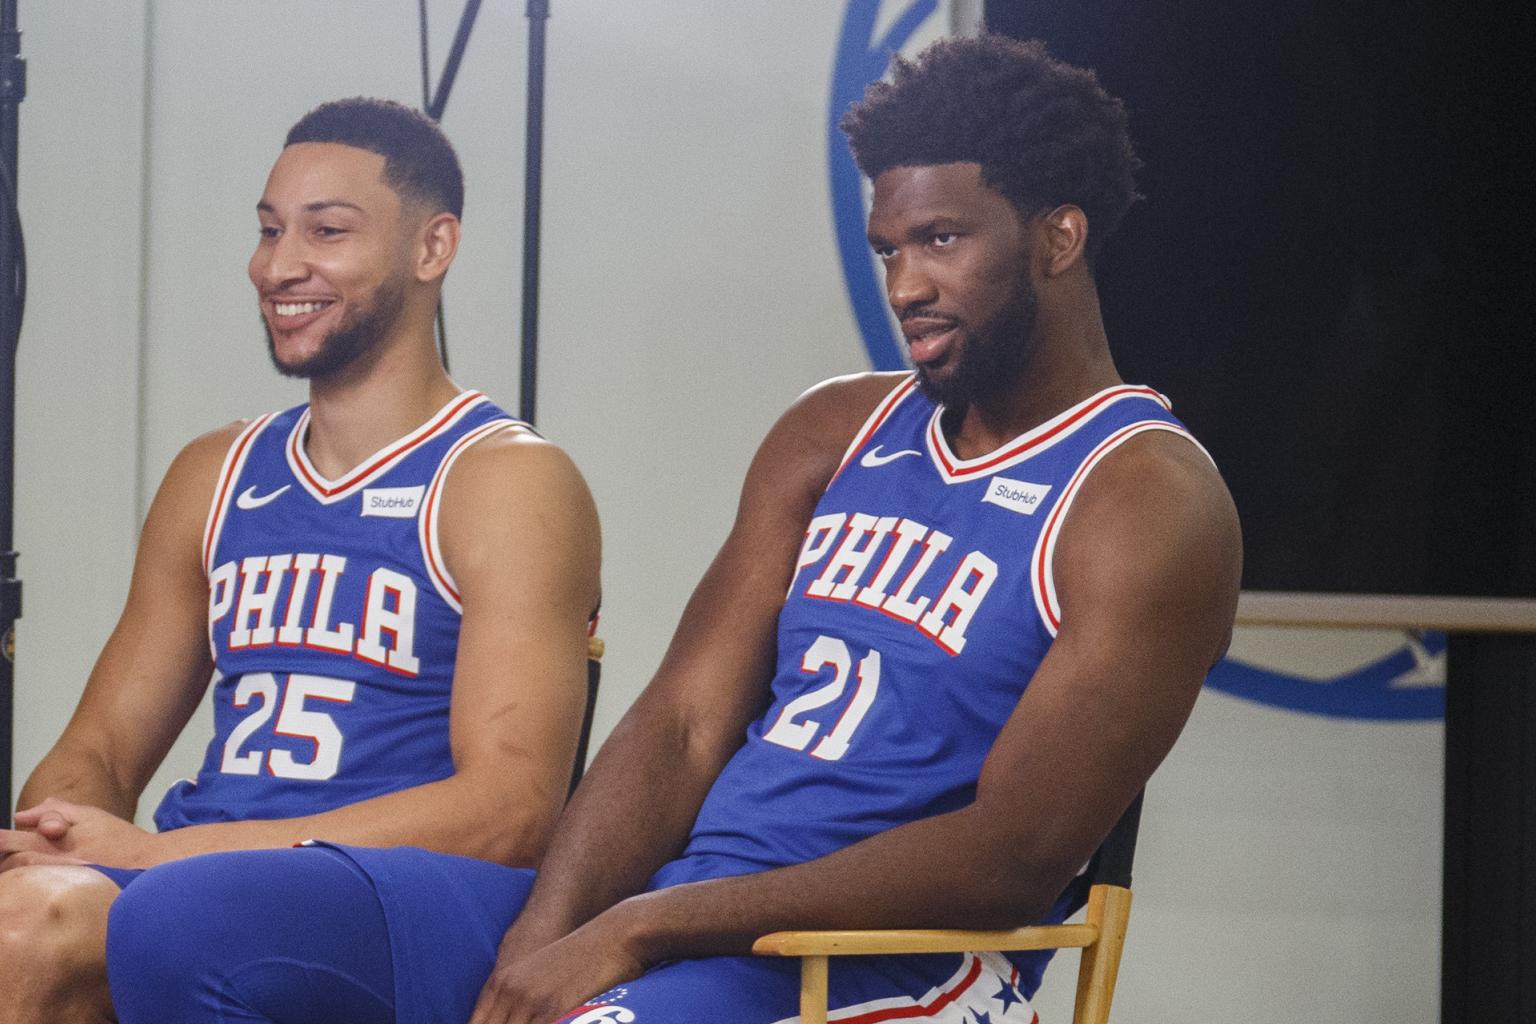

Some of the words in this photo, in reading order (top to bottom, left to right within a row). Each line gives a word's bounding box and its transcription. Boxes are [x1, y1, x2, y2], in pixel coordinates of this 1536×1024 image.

[370, 495, 414, 508] StubHub
[994, 484, 1038, 505] StubHub
[209, 552, 420, 677] PHILA
[797, 511, 999, 657] PHILA
[219, 672, 357, 781] 25
[762, 634, 881, 761] 21
